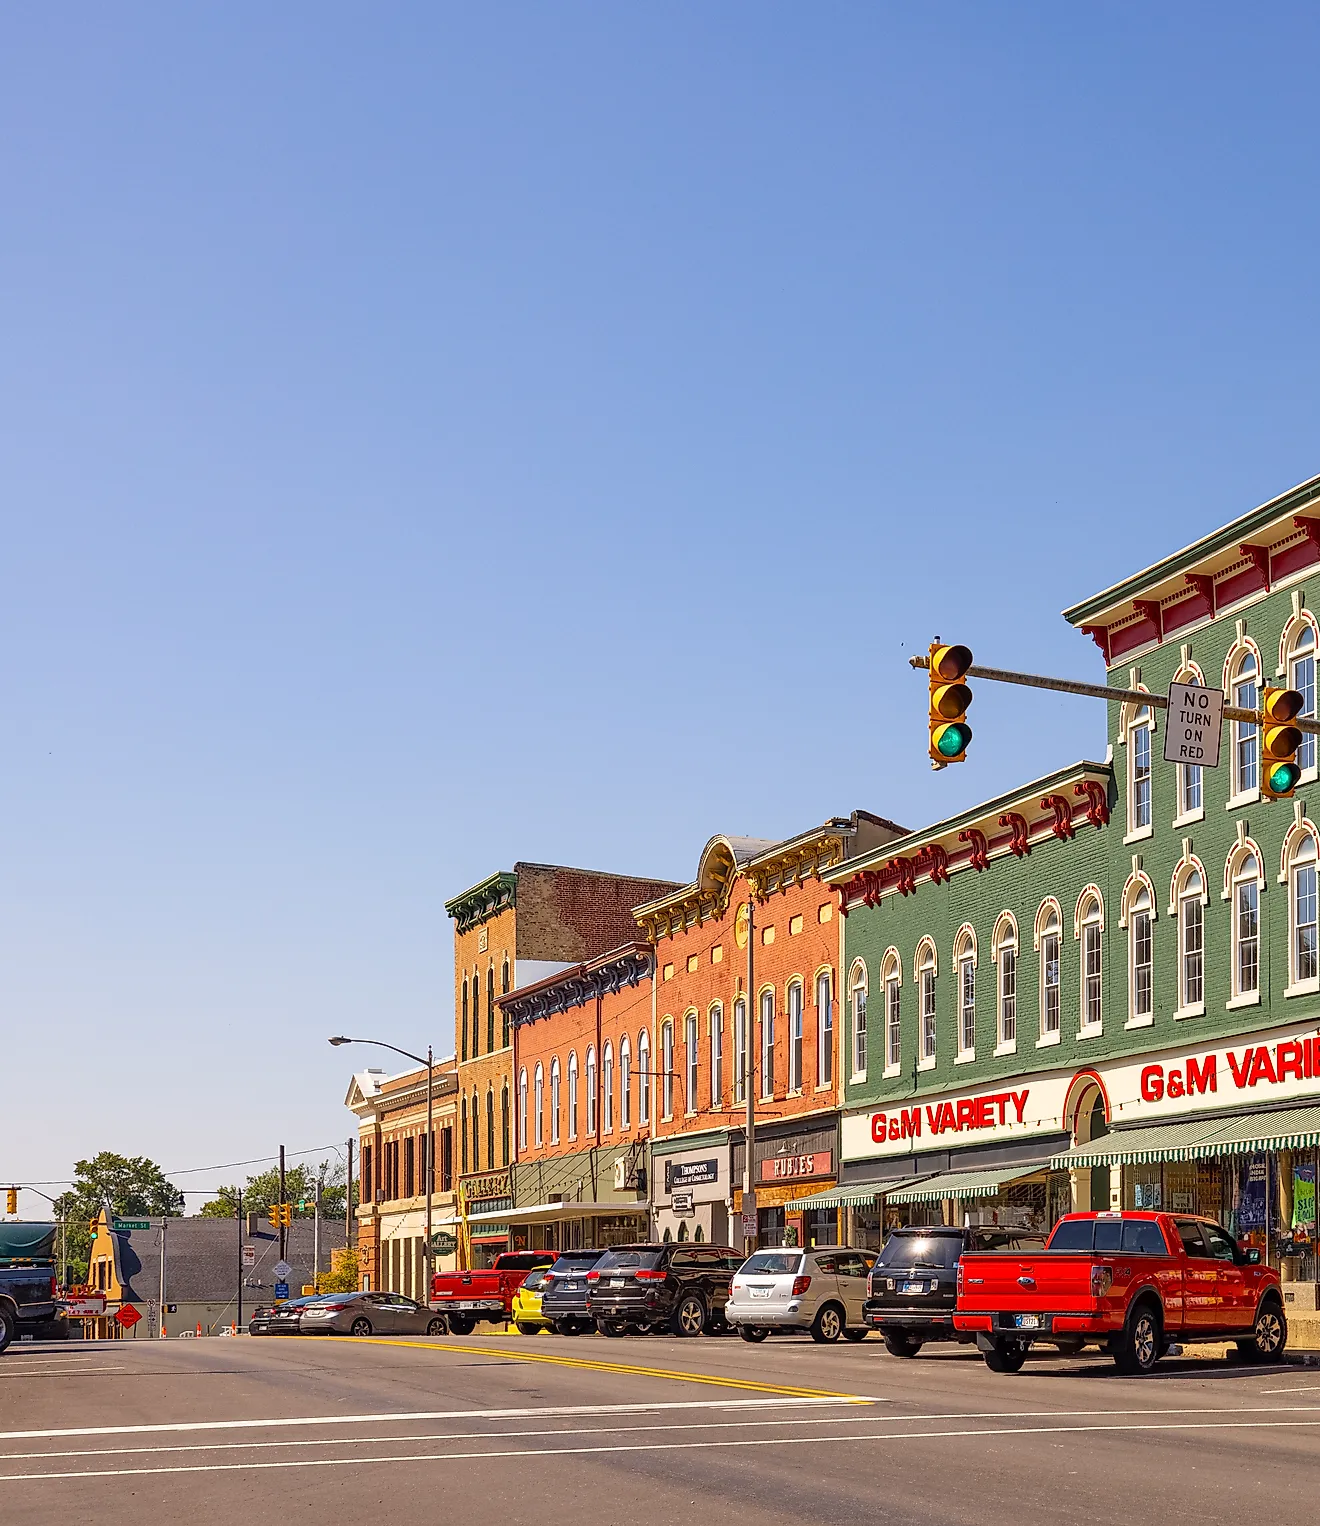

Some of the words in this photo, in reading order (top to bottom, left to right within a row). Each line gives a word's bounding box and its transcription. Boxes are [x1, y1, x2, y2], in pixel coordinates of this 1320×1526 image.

[1184, 692, 1209, 709] NO
[1180, 710, 1211, 726] TURN
[1184, 728, 1202, 742] ON
[1180, 745, 1204, 759] RED
[1140, 1055, 1217, 1103] G&M
[871, 1107, 921, 1143] G&M
[926, 1089, 1030, 1135] VARIETY
[774, 1155, 815, 1177] RUBIES
